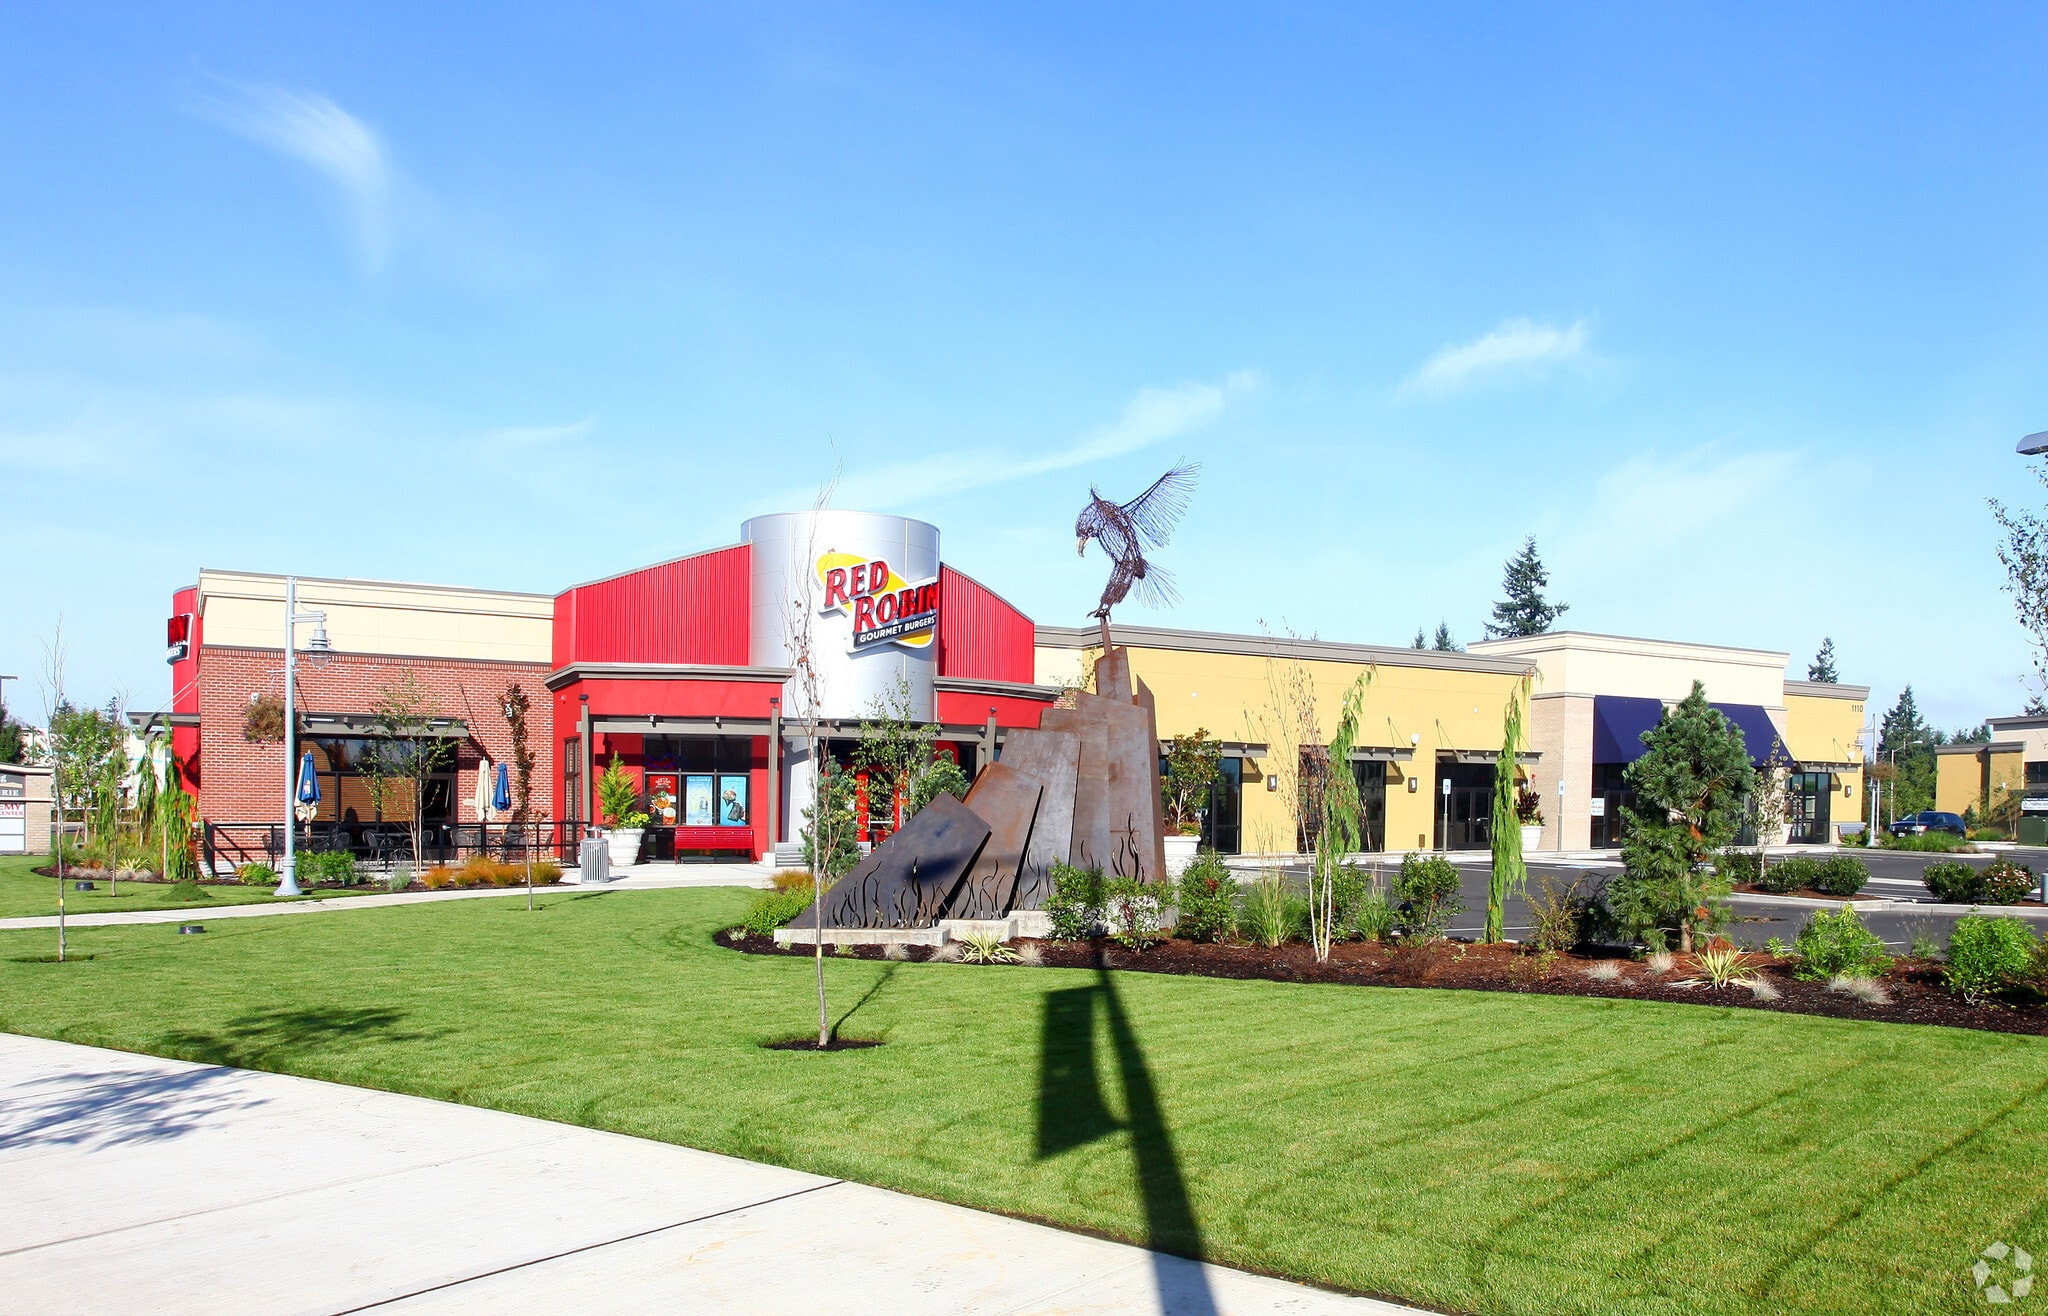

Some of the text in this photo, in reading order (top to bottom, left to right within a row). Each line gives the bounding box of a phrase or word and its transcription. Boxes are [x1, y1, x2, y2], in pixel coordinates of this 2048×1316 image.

[824, 561, 889, 608] RED
[853, 582, 939, 634] ROBIN
[859, 616, 936, 643] GOURMET BURGERS
[1851, 704, 1864, 713] 1110
